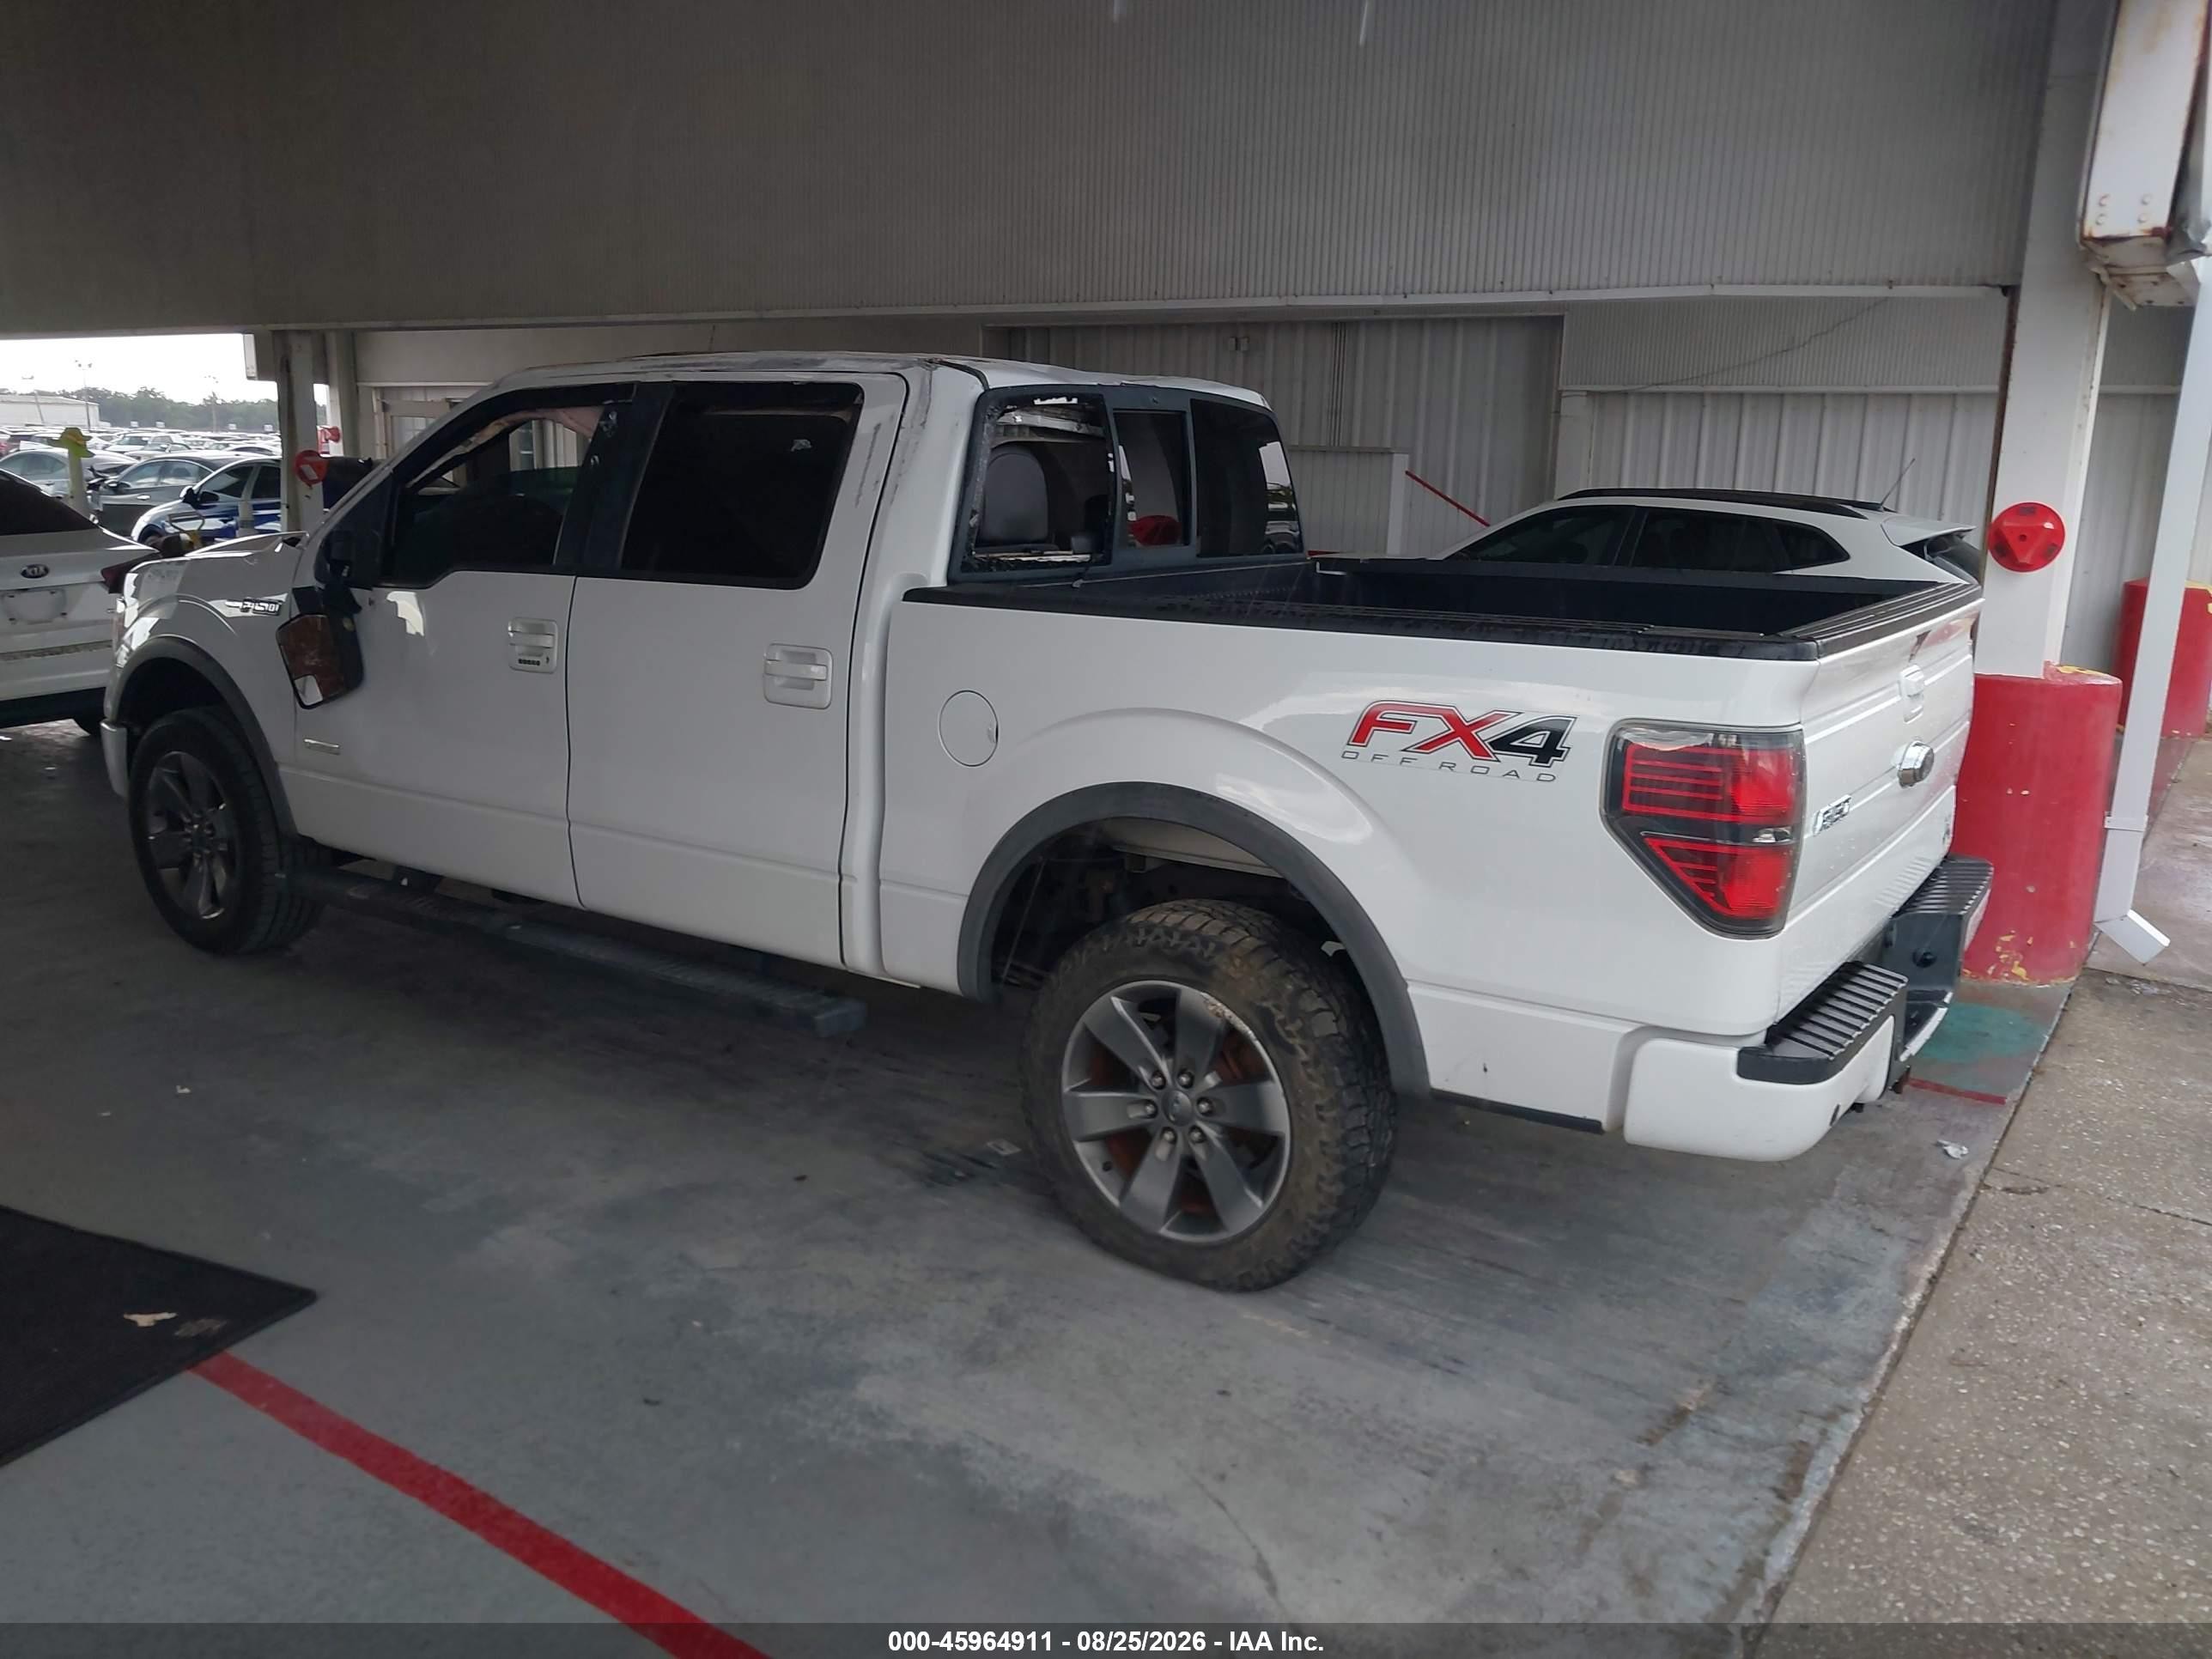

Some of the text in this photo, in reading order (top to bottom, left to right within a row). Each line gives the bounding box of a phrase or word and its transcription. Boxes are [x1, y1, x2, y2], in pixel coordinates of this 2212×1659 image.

[1346, 699, 1578, 769] FX4
[1340, 750, 1558, 783] OFF ROAD
